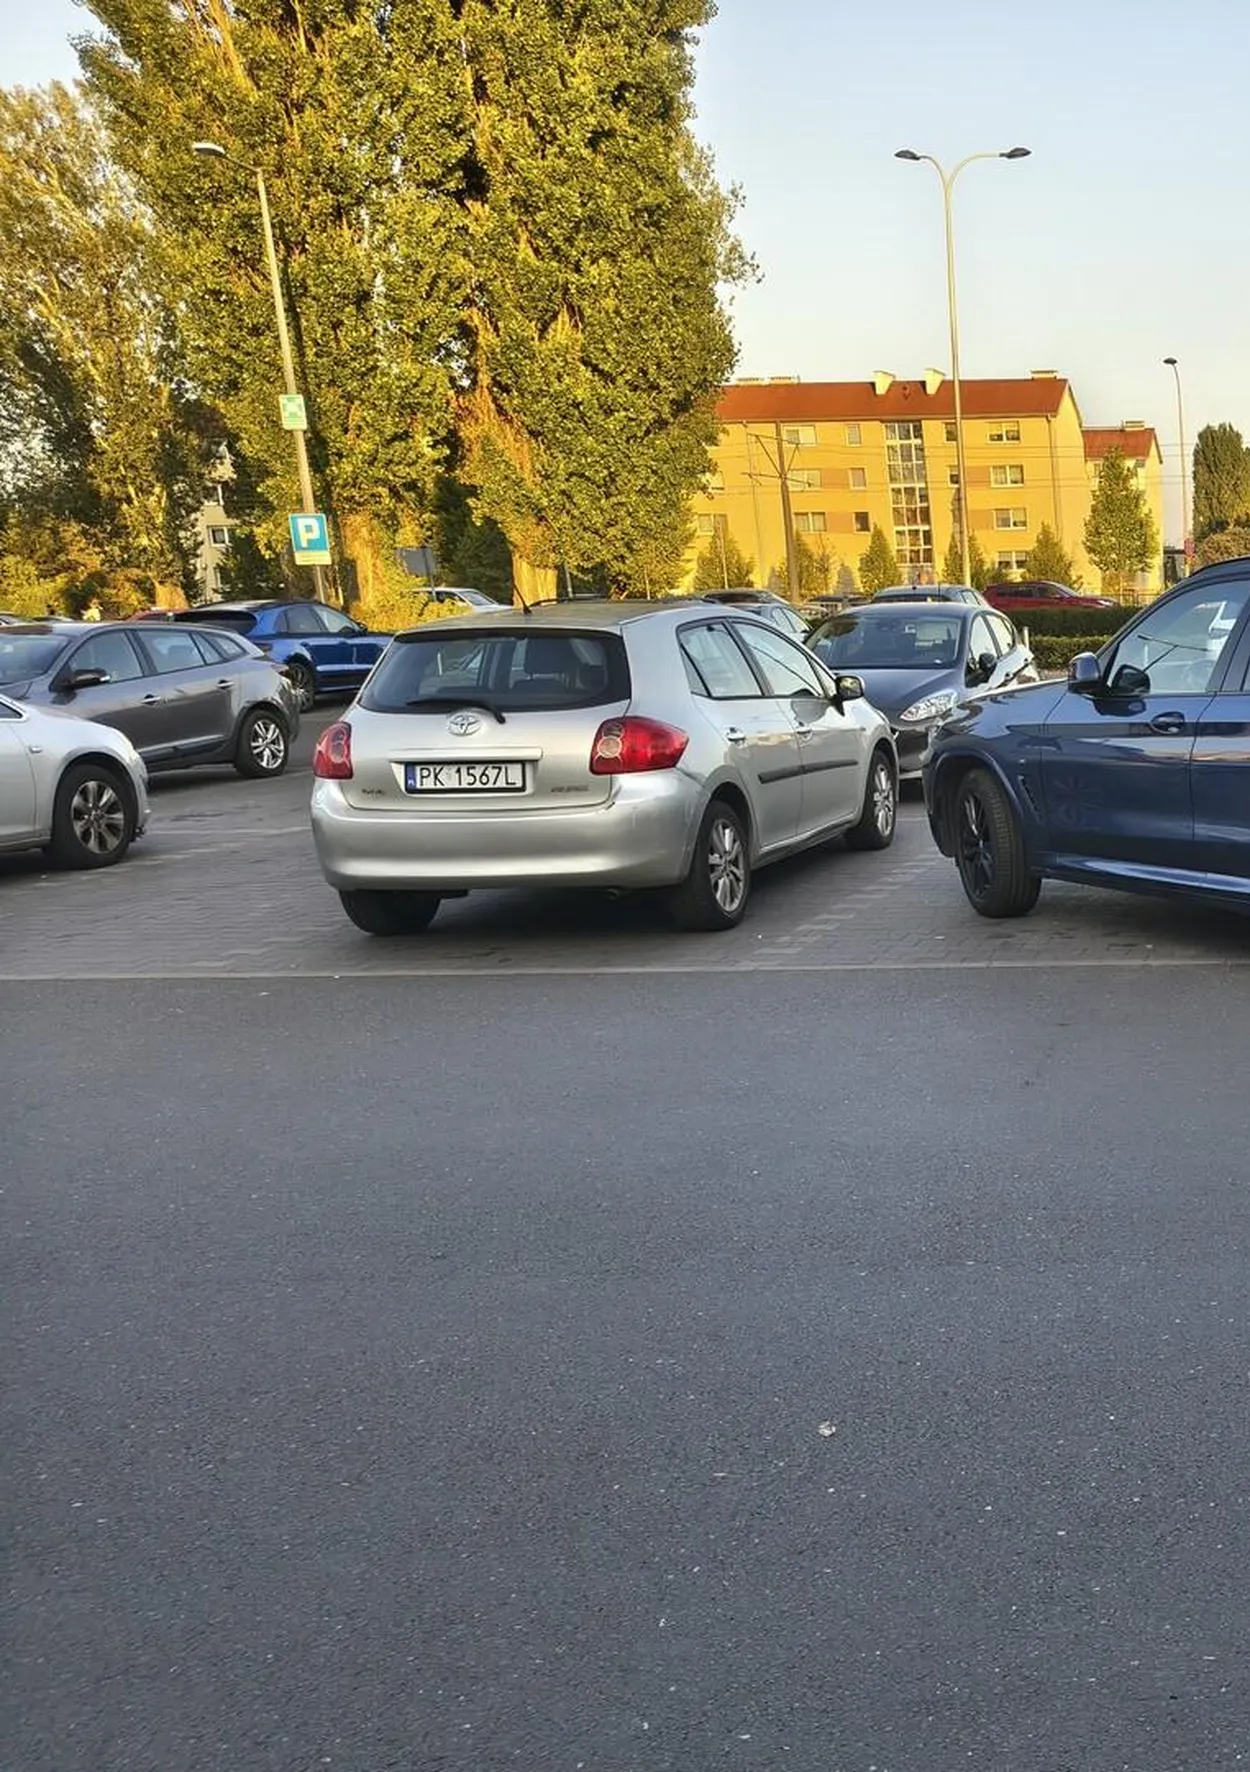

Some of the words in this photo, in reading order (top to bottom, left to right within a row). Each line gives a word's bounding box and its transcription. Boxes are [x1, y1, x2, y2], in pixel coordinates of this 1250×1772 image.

[297, 517, 321, 549] P
[419, 766, 445, 786] PK
[455, 765, 516, 786] 1567L
